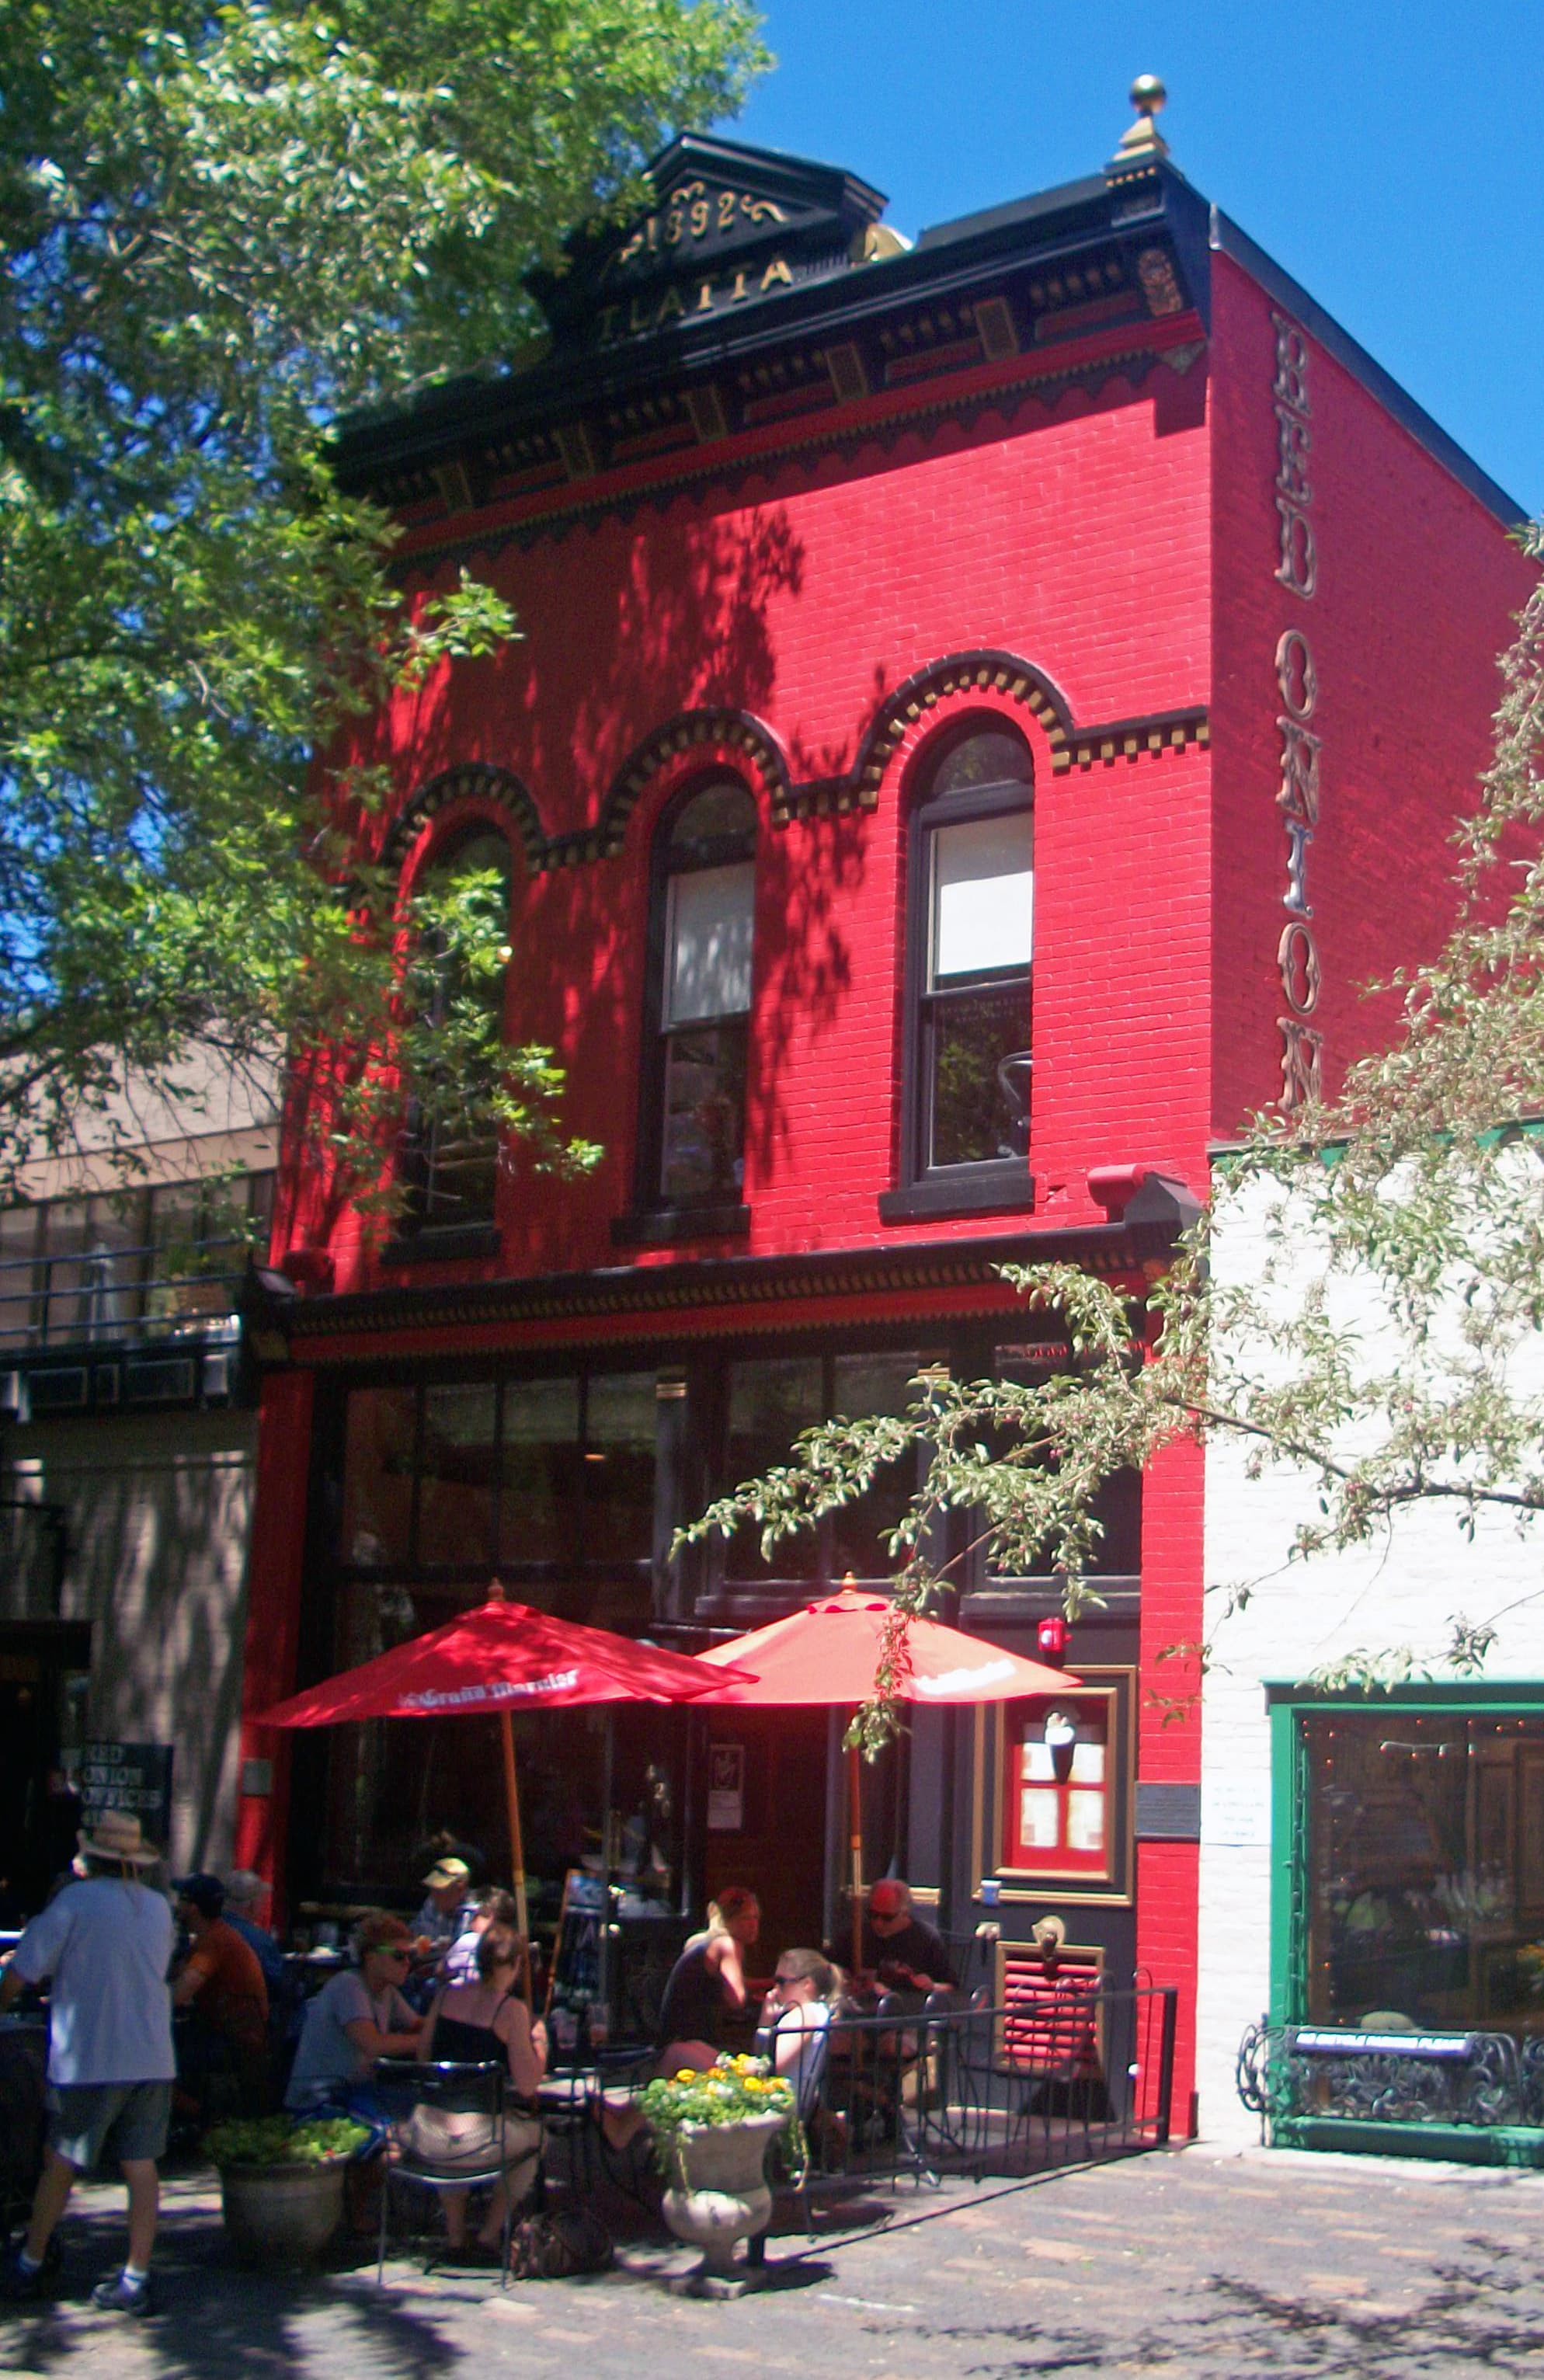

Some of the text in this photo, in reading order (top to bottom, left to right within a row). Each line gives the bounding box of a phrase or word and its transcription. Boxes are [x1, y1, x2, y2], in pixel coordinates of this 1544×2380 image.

[645, 189, 738, 253] 1892
[1271, 311, 1323, 1113] RED ONION
[419, 1686, 485, 1707] Grand
[489, 1668, 579, 1699] Marnier
